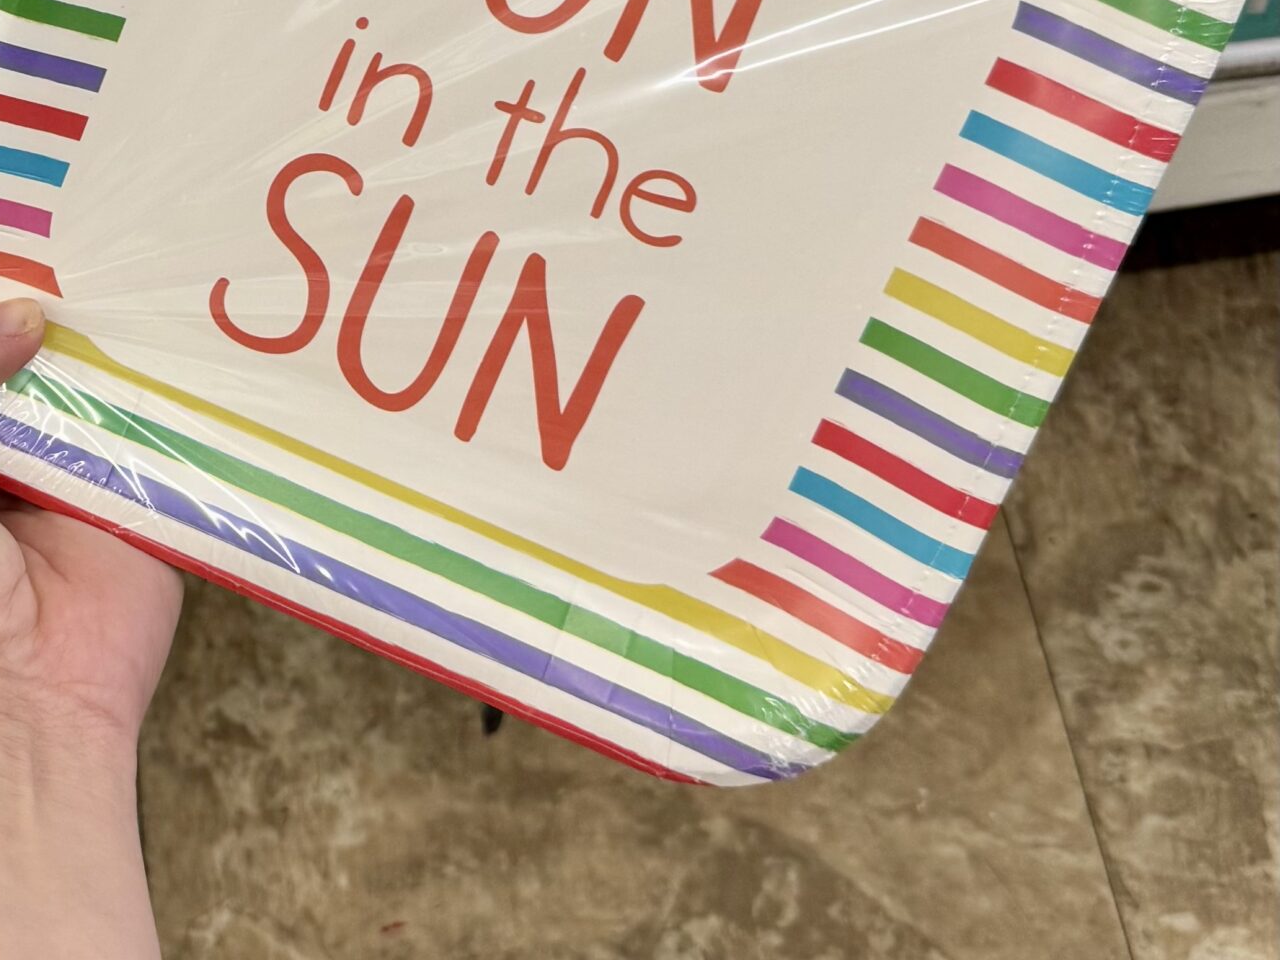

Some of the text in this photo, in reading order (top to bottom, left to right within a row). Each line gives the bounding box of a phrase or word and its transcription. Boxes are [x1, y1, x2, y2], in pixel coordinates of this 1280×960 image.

[318, 16, 698, 248] in the
[209, 152, 646, 472] SUN
